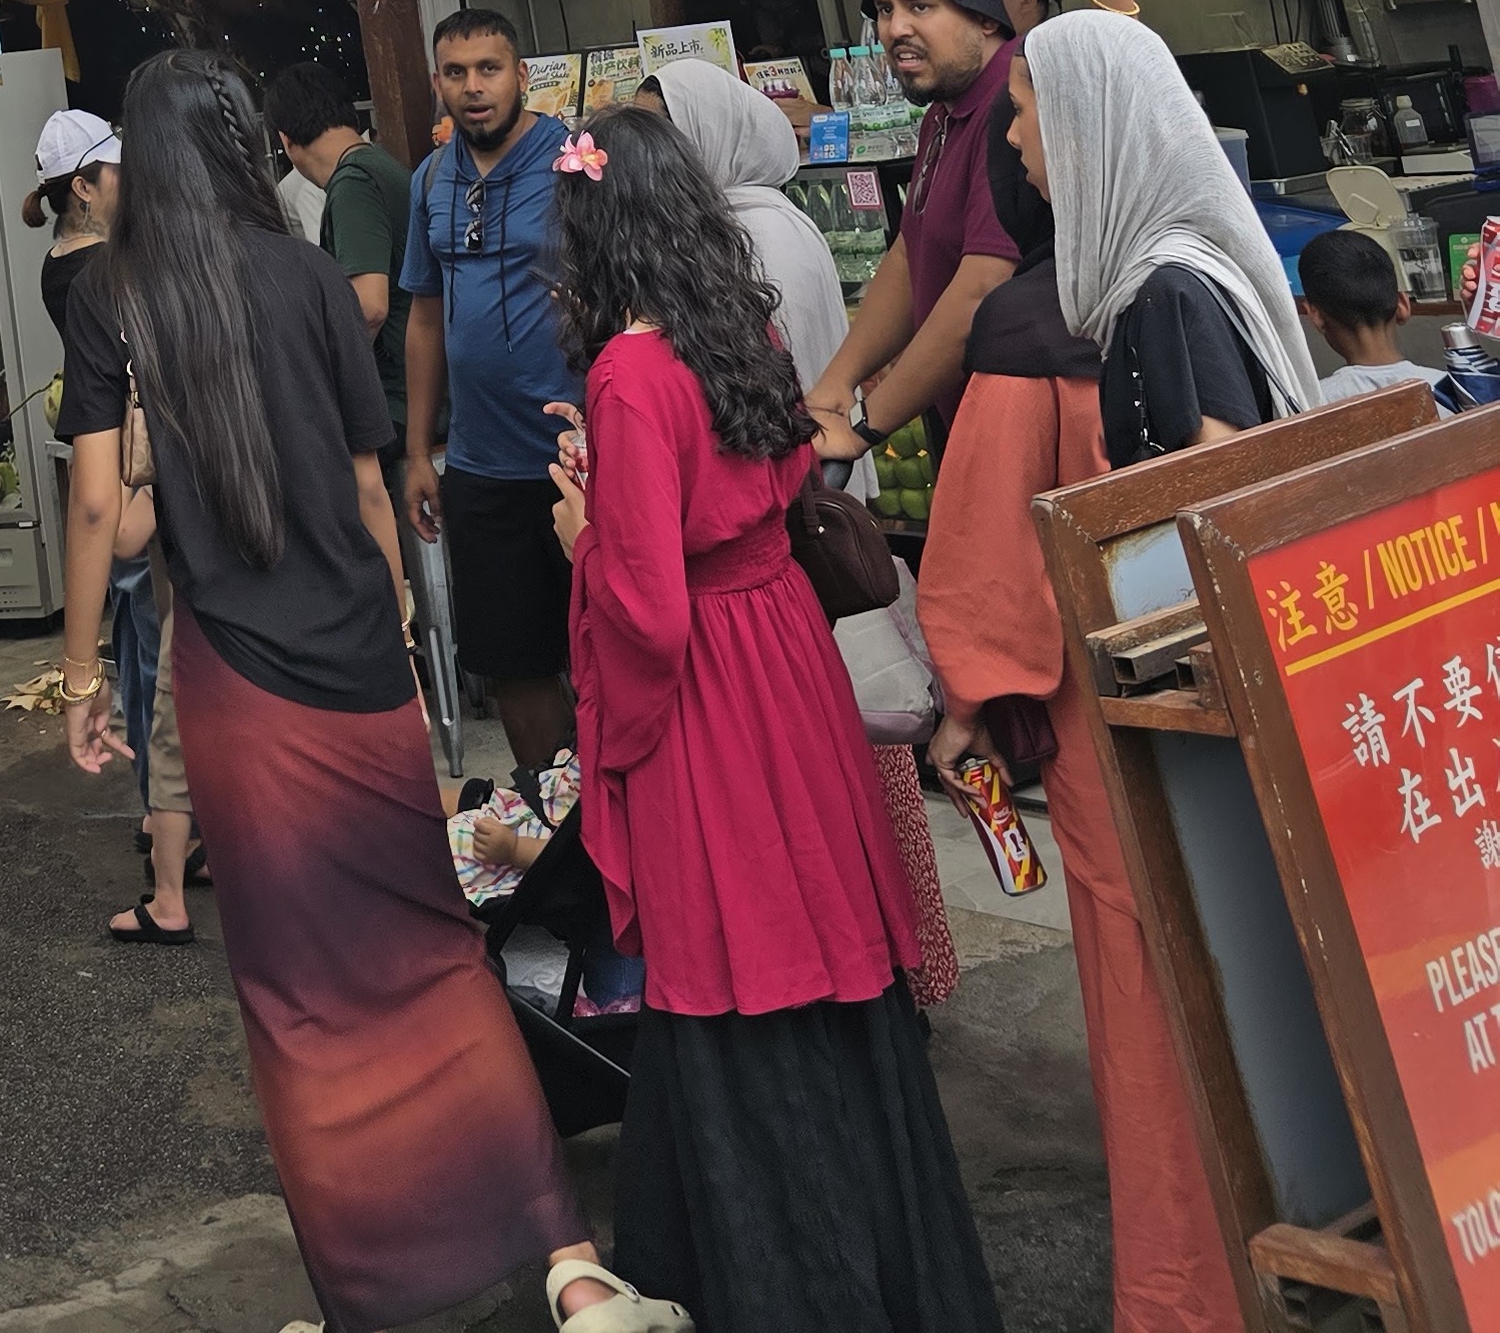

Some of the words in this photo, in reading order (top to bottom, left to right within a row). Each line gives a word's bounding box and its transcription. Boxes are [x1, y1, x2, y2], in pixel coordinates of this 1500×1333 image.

[1266, 560, 1359, 652] 注意
[1376, 514, 1478, 599] NOTICE
[1397, 737, 1500, 845] 在出
